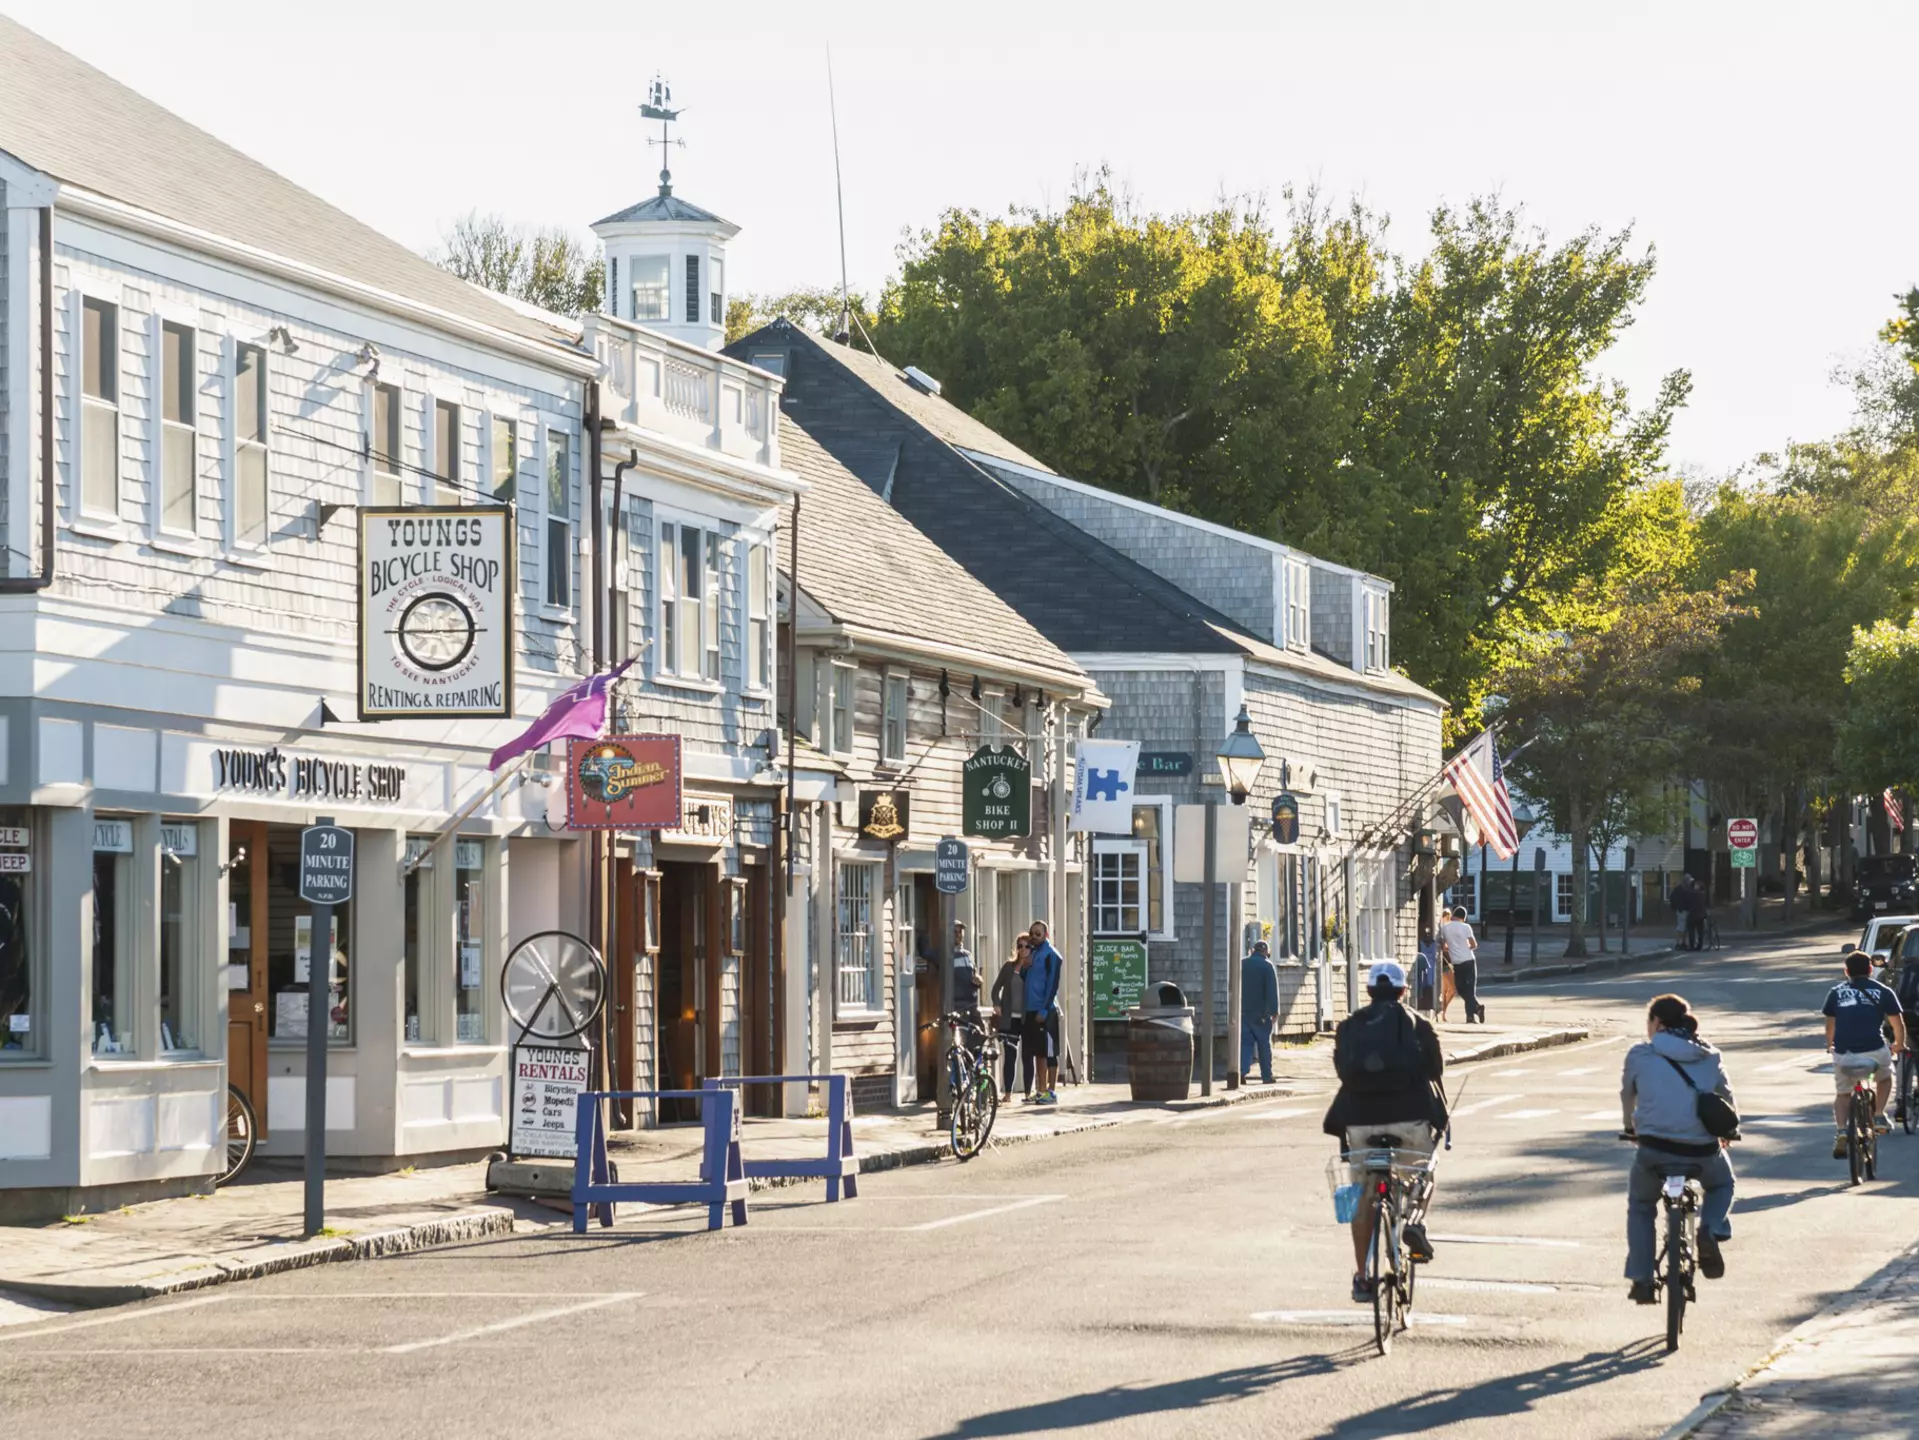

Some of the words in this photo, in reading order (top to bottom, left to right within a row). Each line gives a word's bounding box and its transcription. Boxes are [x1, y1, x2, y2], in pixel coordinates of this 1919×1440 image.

[388, 519, 482, 547] YOUNGS
[371, 551, 442, 597] BICYCLE
[450, 553, 499, 593] SHOP
[386, 597, 400, 613] THE
[399, 577, 424, 598] CYCLE
[433, 575, 468, 594] LOGICAL
[468, 593, 485, 613] WAY
[391, 656, 402, 669] TO
[402, 668, 418, 682] SEE
[423, 654, 481, 685] NANTUCKET
[368, 682, 422, 707] RENTING
[436, 681, 501, 707] REPAIRING
[609, 761, 662, 780] Indian
[966, 755, 1029, 772] NANTUCKET
[1152, 757, 1184, 770] Bar
[217, 747, 286, 791] YOUNG'S
[295, 756, 362, 799] BICYCLE
[368, 764, 406, 801] SHOP
[607, 770, 670, 795] Summer
[985, 805, 1011, 816] BIKE
[975, 820, 1005, 830] SHOP
[1010, 820, 1018, 830] II
[320, 833, 337, 849] 20
[947, 844, 958, 855] 20
[305, 854, 350, 869] MINUTE
[938, 859, 967, 869] MINUTE
[305, 874, 348, 889] PARKING
[939, 872, 965, 882] PARKING
[1096, 944, 1118, 952] JUICE
[1120, 945, 1136, 953] BAR
[527, 1048, 580, 1065] YOUNGS
[519, 1063, 586, 1081] RENTALS
[544, 1084, 577, 1095] Bicycles
[544, 1096, 574, 1107] Mopeds
[542, 1107, 562, 1117] Cars
[542, 1119, 565, 1129] Jeeps
